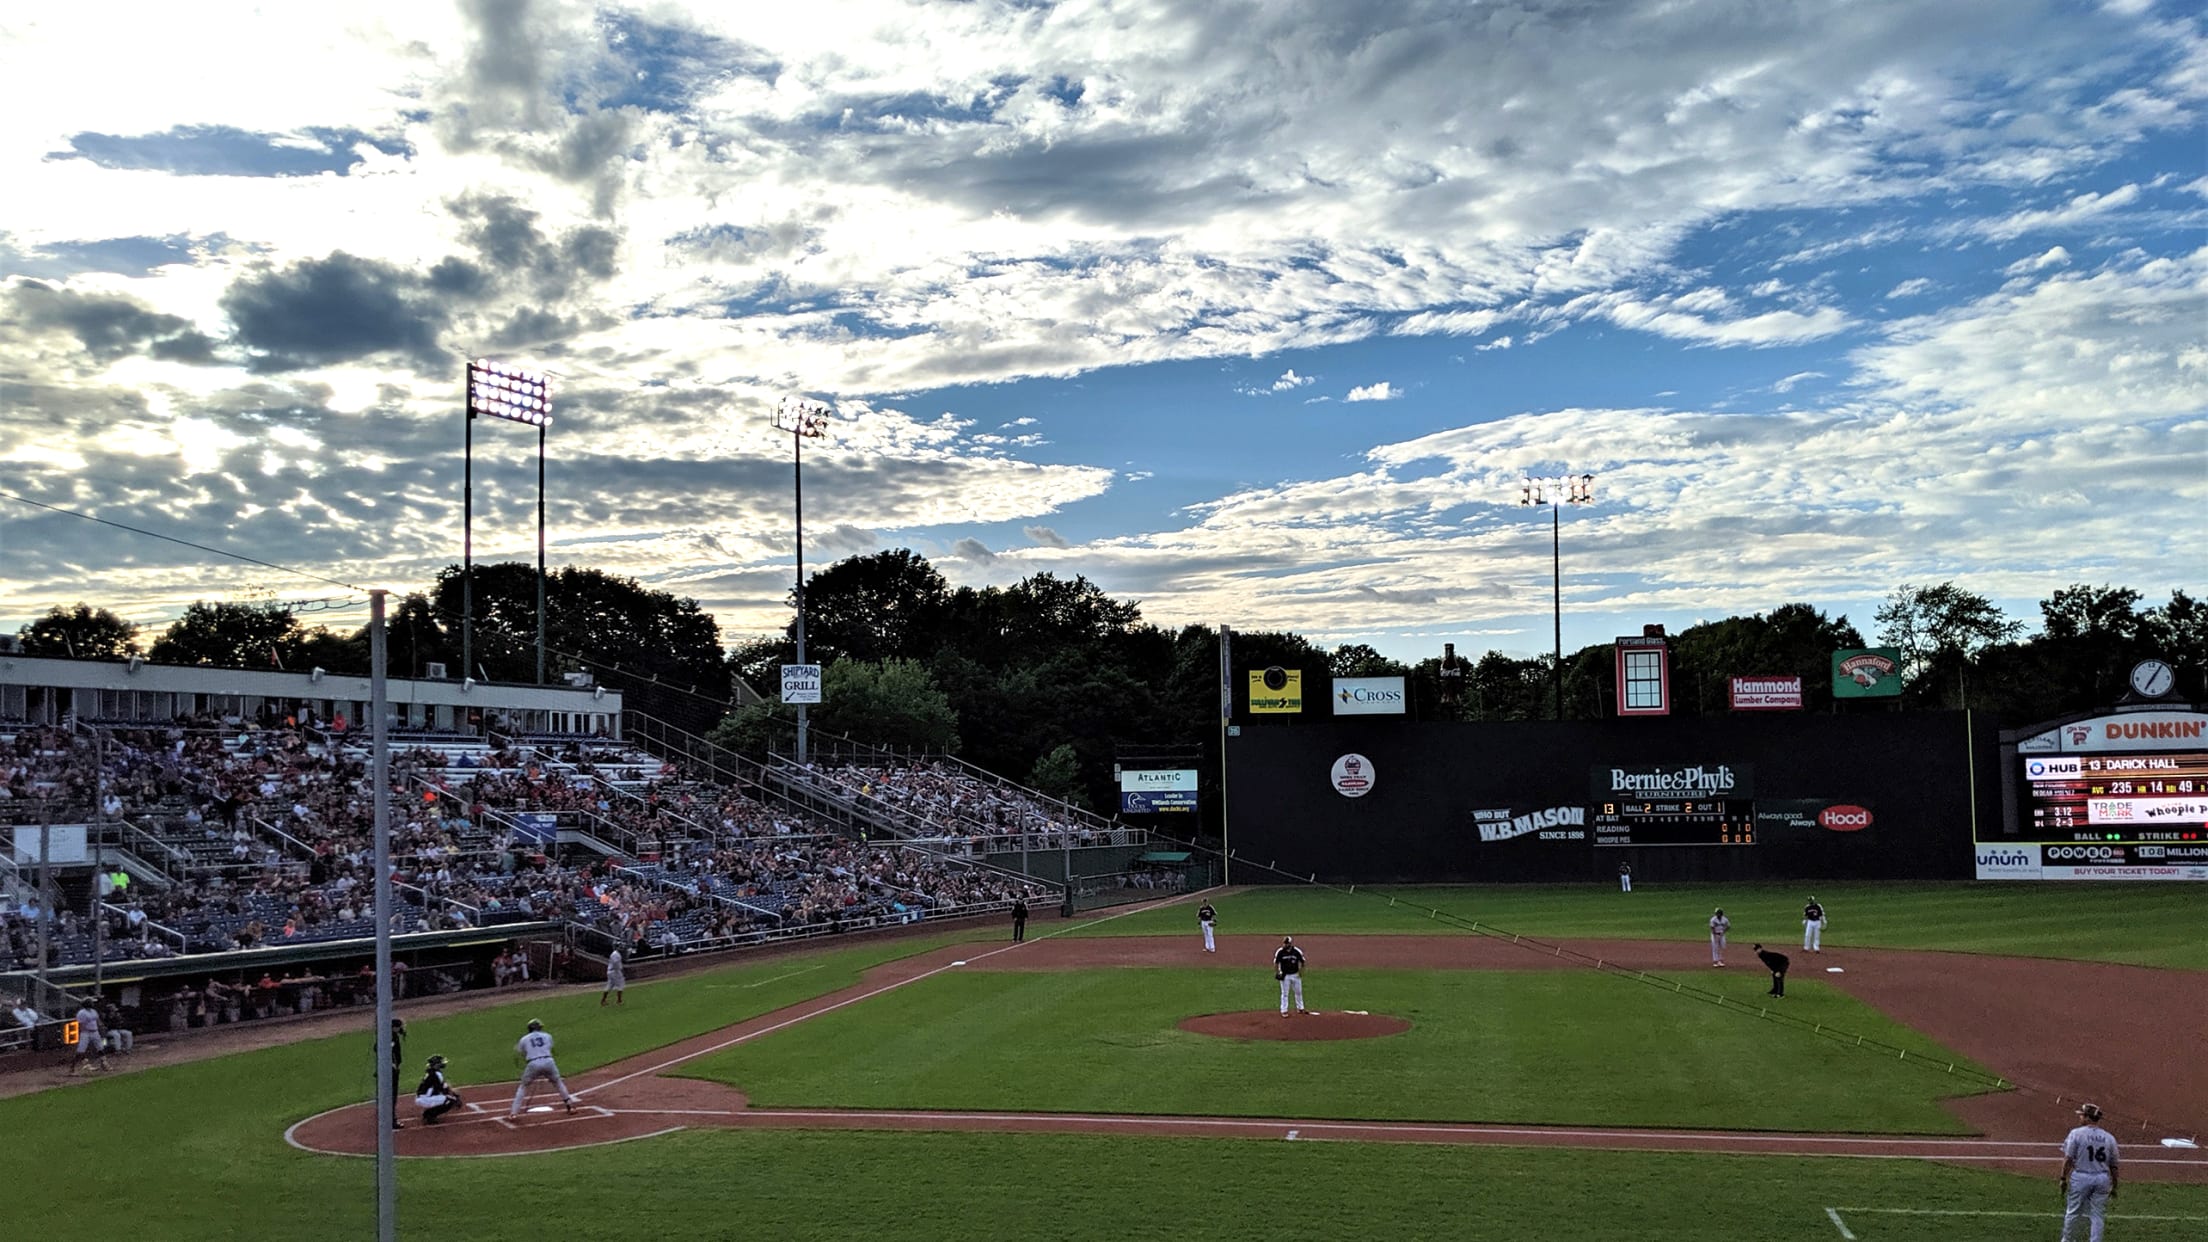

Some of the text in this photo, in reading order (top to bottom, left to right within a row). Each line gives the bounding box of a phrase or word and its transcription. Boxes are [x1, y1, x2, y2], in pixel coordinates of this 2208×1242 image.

[1843, 657, 1891, 672] Hannaford
[783, 666, 819, 679] SHIPYARD
[784, 681, 818, 690] GRILL
[1733, 678, 1800, 692] Hammond
[1736, 696, 1800, 704] Lumber Company
[2106, 721, 2206, 740] DUNKIN'
[2050, 764, 2078, 773] HUB
[2089, 759, 2178, 770] 13 DARICK HALL
[1138, 773, 1181, 782] ATLANTIC
[2109, 782, 2132, 793] .235
[2151, 782, 2162, 792] 14
[2179, 781, 2192, 792] 49
[1604, 804, 1614, 814] 13
[1644, 803, 1651, 814] 2
[1685, 802, 1692, 812] 2
[2054, 807, 2072, 816] 3.12
[2093, 802, 2133, 810] TRADE
[2145, 804, 2195, 818] Whoopie
[1494, 810, 1510, 819] BUT
[2099, 808, 2133, 816] MARK
[1825, 812, 1866, 824] Hood
[1722, 824, 1727, 832] 0
[1745, 824, 1751, 832] 0
[1722, 834, 1728, 843] 0
[1746, 834, 1751, 843] 0
[2048, 847, 2112, 859] POWER
[2167, 848, 2208, 856] MILLION
[64, 1022, 79, 1044] 13
[530, 1038, 544, 1048] 13
[2087, 1146, 2106, 1162] 16
